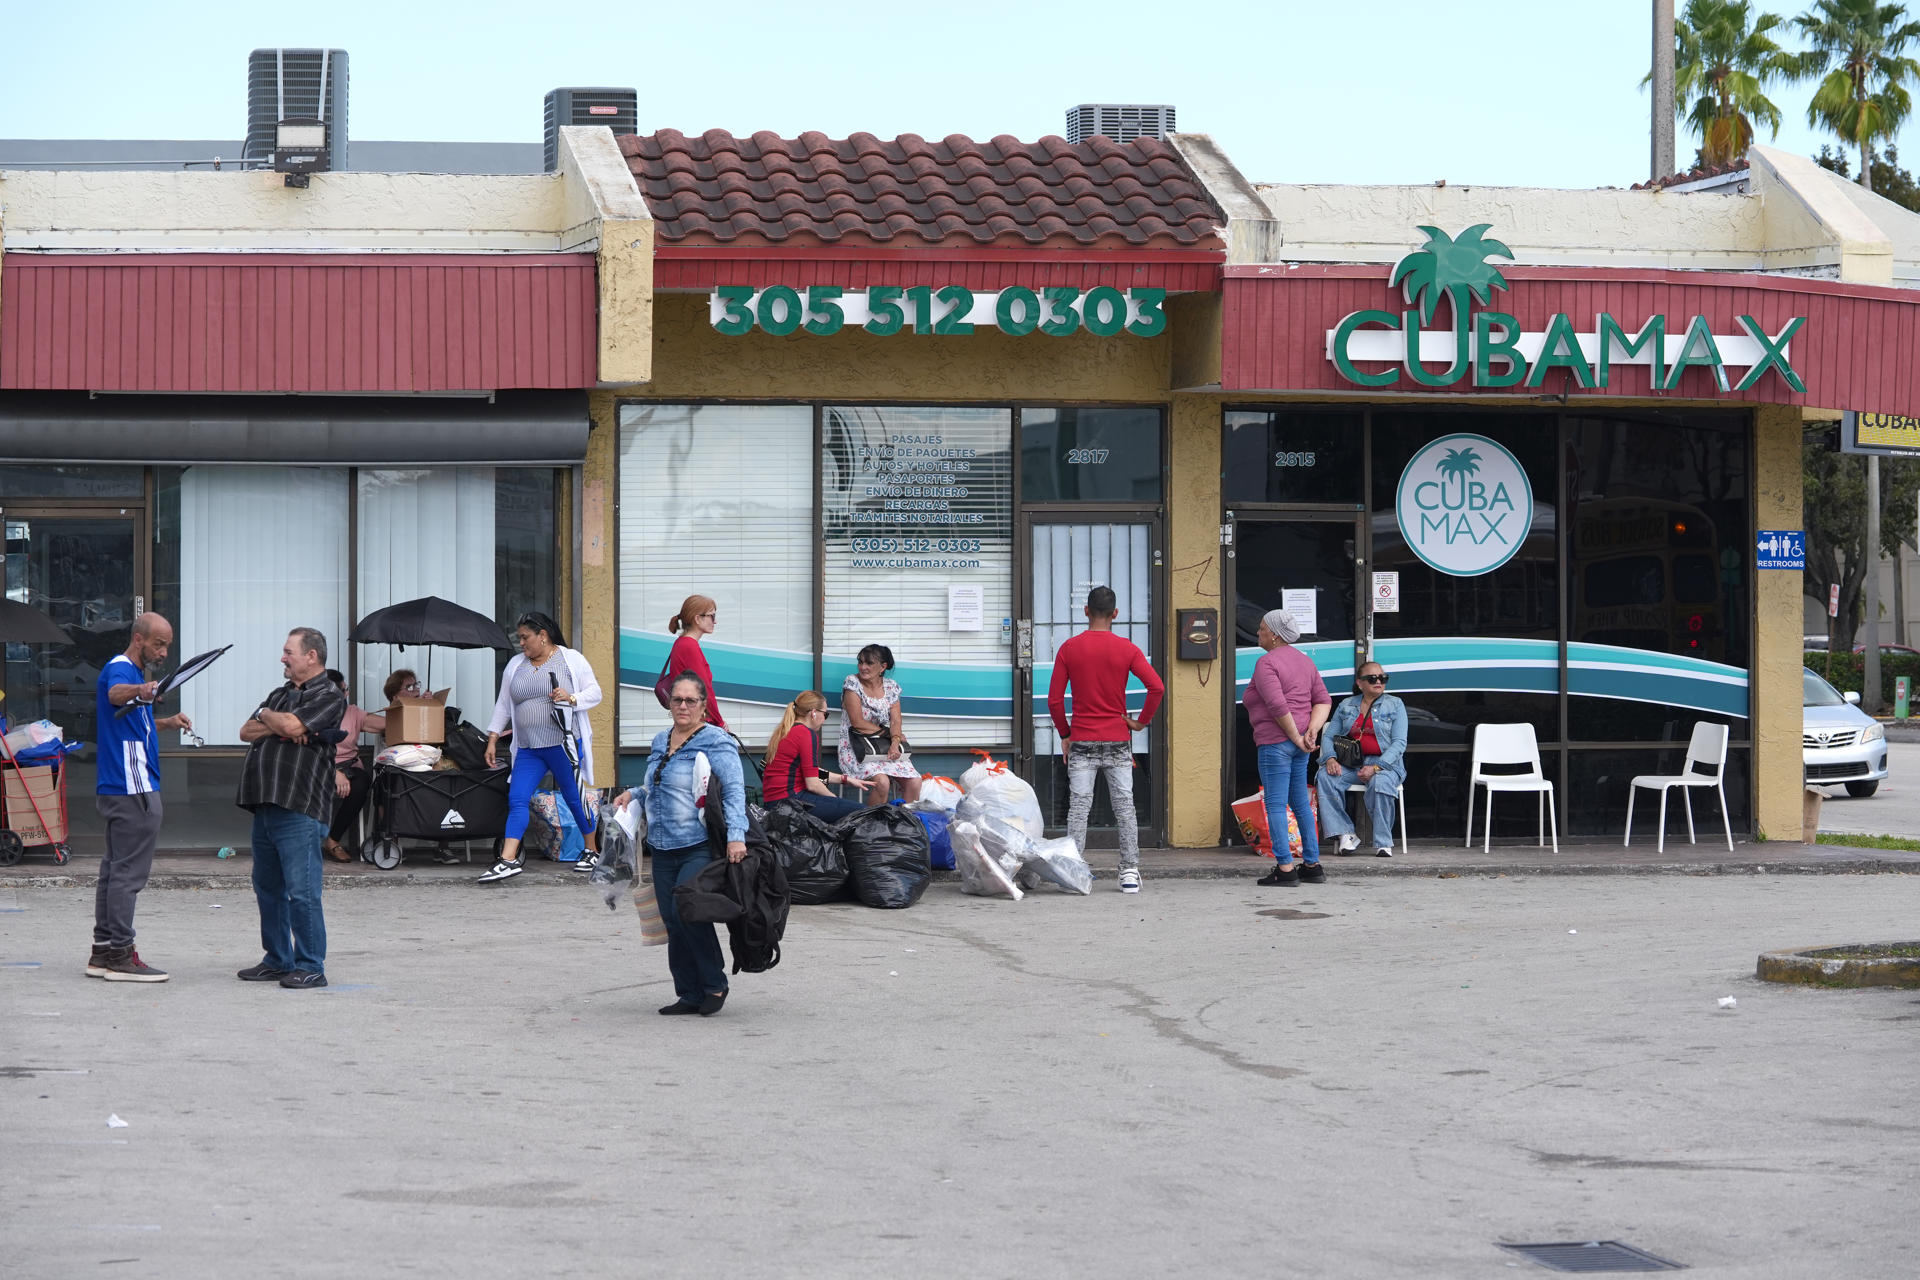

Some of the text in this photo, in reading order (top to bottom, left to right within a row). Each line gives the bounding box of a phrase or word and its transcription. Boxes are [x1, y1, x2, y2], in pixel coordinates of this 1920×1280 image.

[713, 285, 1167, 338] 305 512 0303
[1330, 309, 1808, 393] CUBAMAX
[892, 435, 943, 445] PASAJES
[858, 446, 976, 459] ENVÍO DE PAQUETES
[1068, 449, 1110, 465] 2817
[1275, 451, 1316, 467] 2815
[864, 461, 970, 471] AUTOS Y HOTELES
[879, 474, 956, 484] PASAPORTES
[865, 485, 969, 498] ENVÍO DE DINERO
[1414, 482, 1514, 511] CUBA
[885, 500, 949, 510] RECARGAS
[849, 510, 984, 524] TRÁMITES NOTARIALES
[1421, 513, 1508, 544] MAX
[851, 538, 982, 553] (305) 512-0303
[852, 557, 981, 568] www.cubamax.com
[1757, 560, 1805, 568] RESTROOMS
